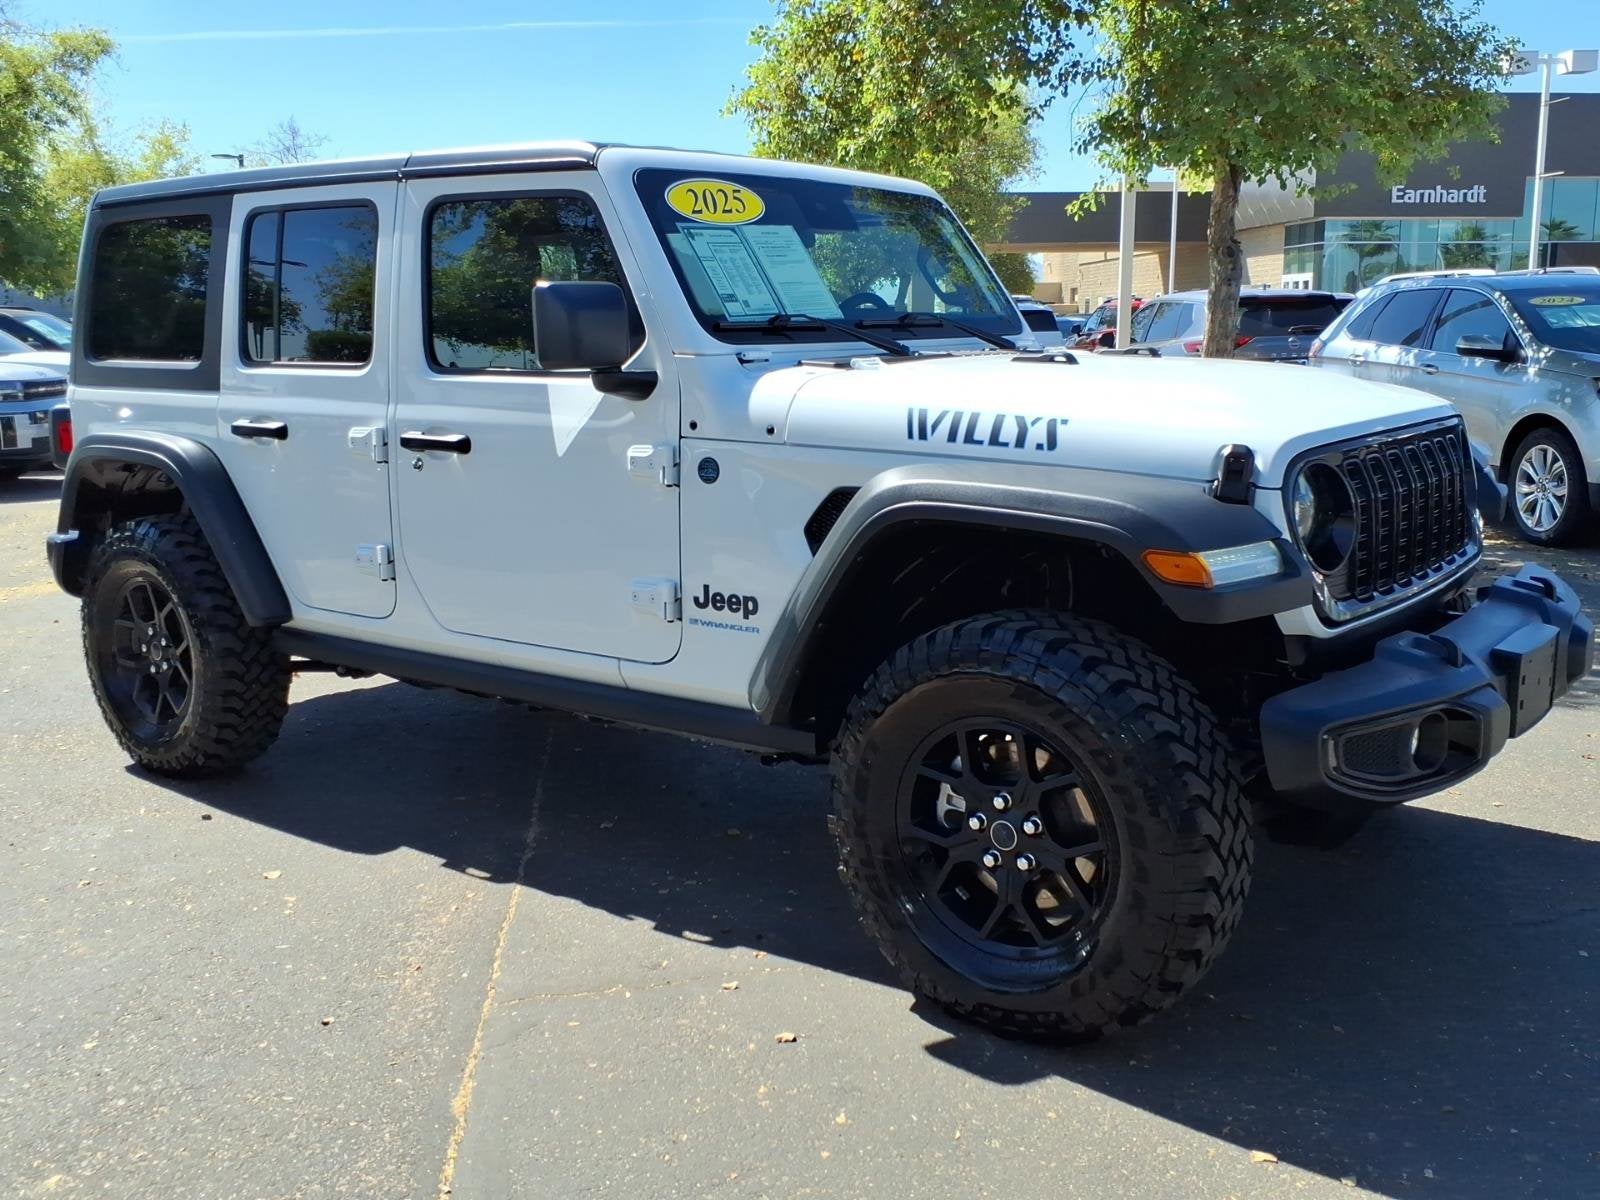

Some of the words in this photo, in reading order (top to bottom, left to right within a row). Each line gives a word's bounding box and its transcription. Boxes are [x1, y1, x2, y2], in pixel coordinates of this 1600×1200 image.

[686, 189, 746, 214] 2025
[1391, 185, 1487, 203] Earnhardt
[907, 408, 1069, 451] WILLYS
[693, 584, 759, 620] Jeep
[700, 619, 760, 634] WRANGLER
